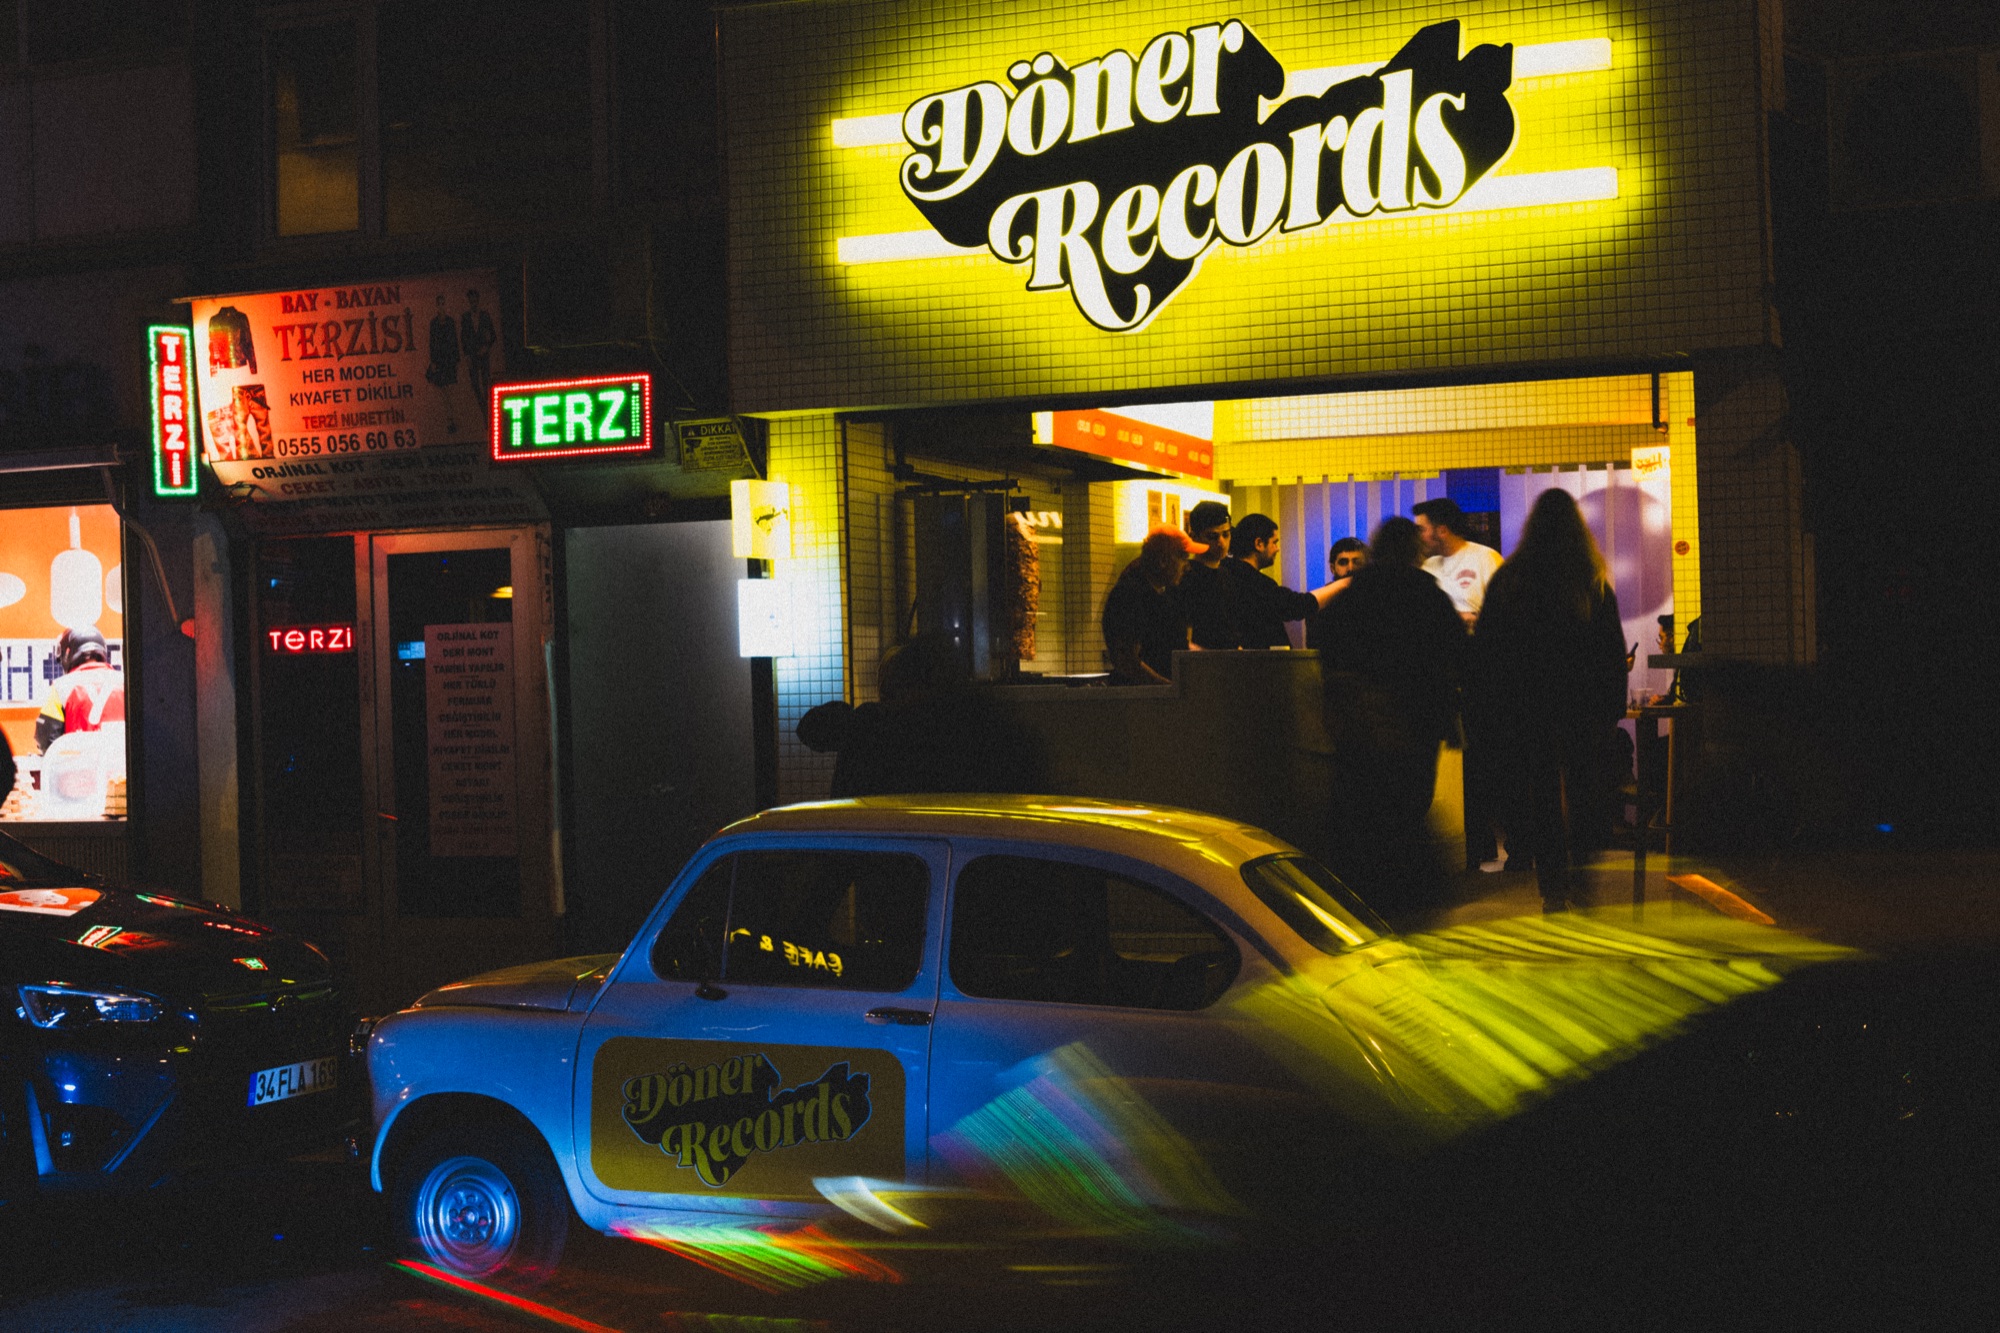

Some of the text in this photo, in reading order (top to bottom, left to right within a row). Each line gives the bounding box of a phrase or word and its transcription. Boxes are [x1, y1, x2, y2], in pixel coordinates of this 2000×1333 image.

[902, 19, 1244, 201] Döner
[988, 68, 1466, 331] Records
[281, 293, 318, 314] BAY
[335, 285, 400, 309] BAYAN
[272, 306, 416, 361] TERZİSİ
[302, 364, 397, 384] HER MODEL
[290, 382, 413, 406] KIYAFET DİKİLİR
[302, 407, 405, 429] TERZİ NURETTİN
[278, 428, 416, 456] 0555 056 60 63
[251, 457, 326, 480] ORJİNAL
[331, 458, 365, 475] KOT
[280, 478, 337, 496] CEKET
[256, 1072, 276, 1102] 34
[277, 1064, 307, 1097] FLA
[623, 1053, 763, 1125] Döner
[661, 1082, 852, 1187] Records
